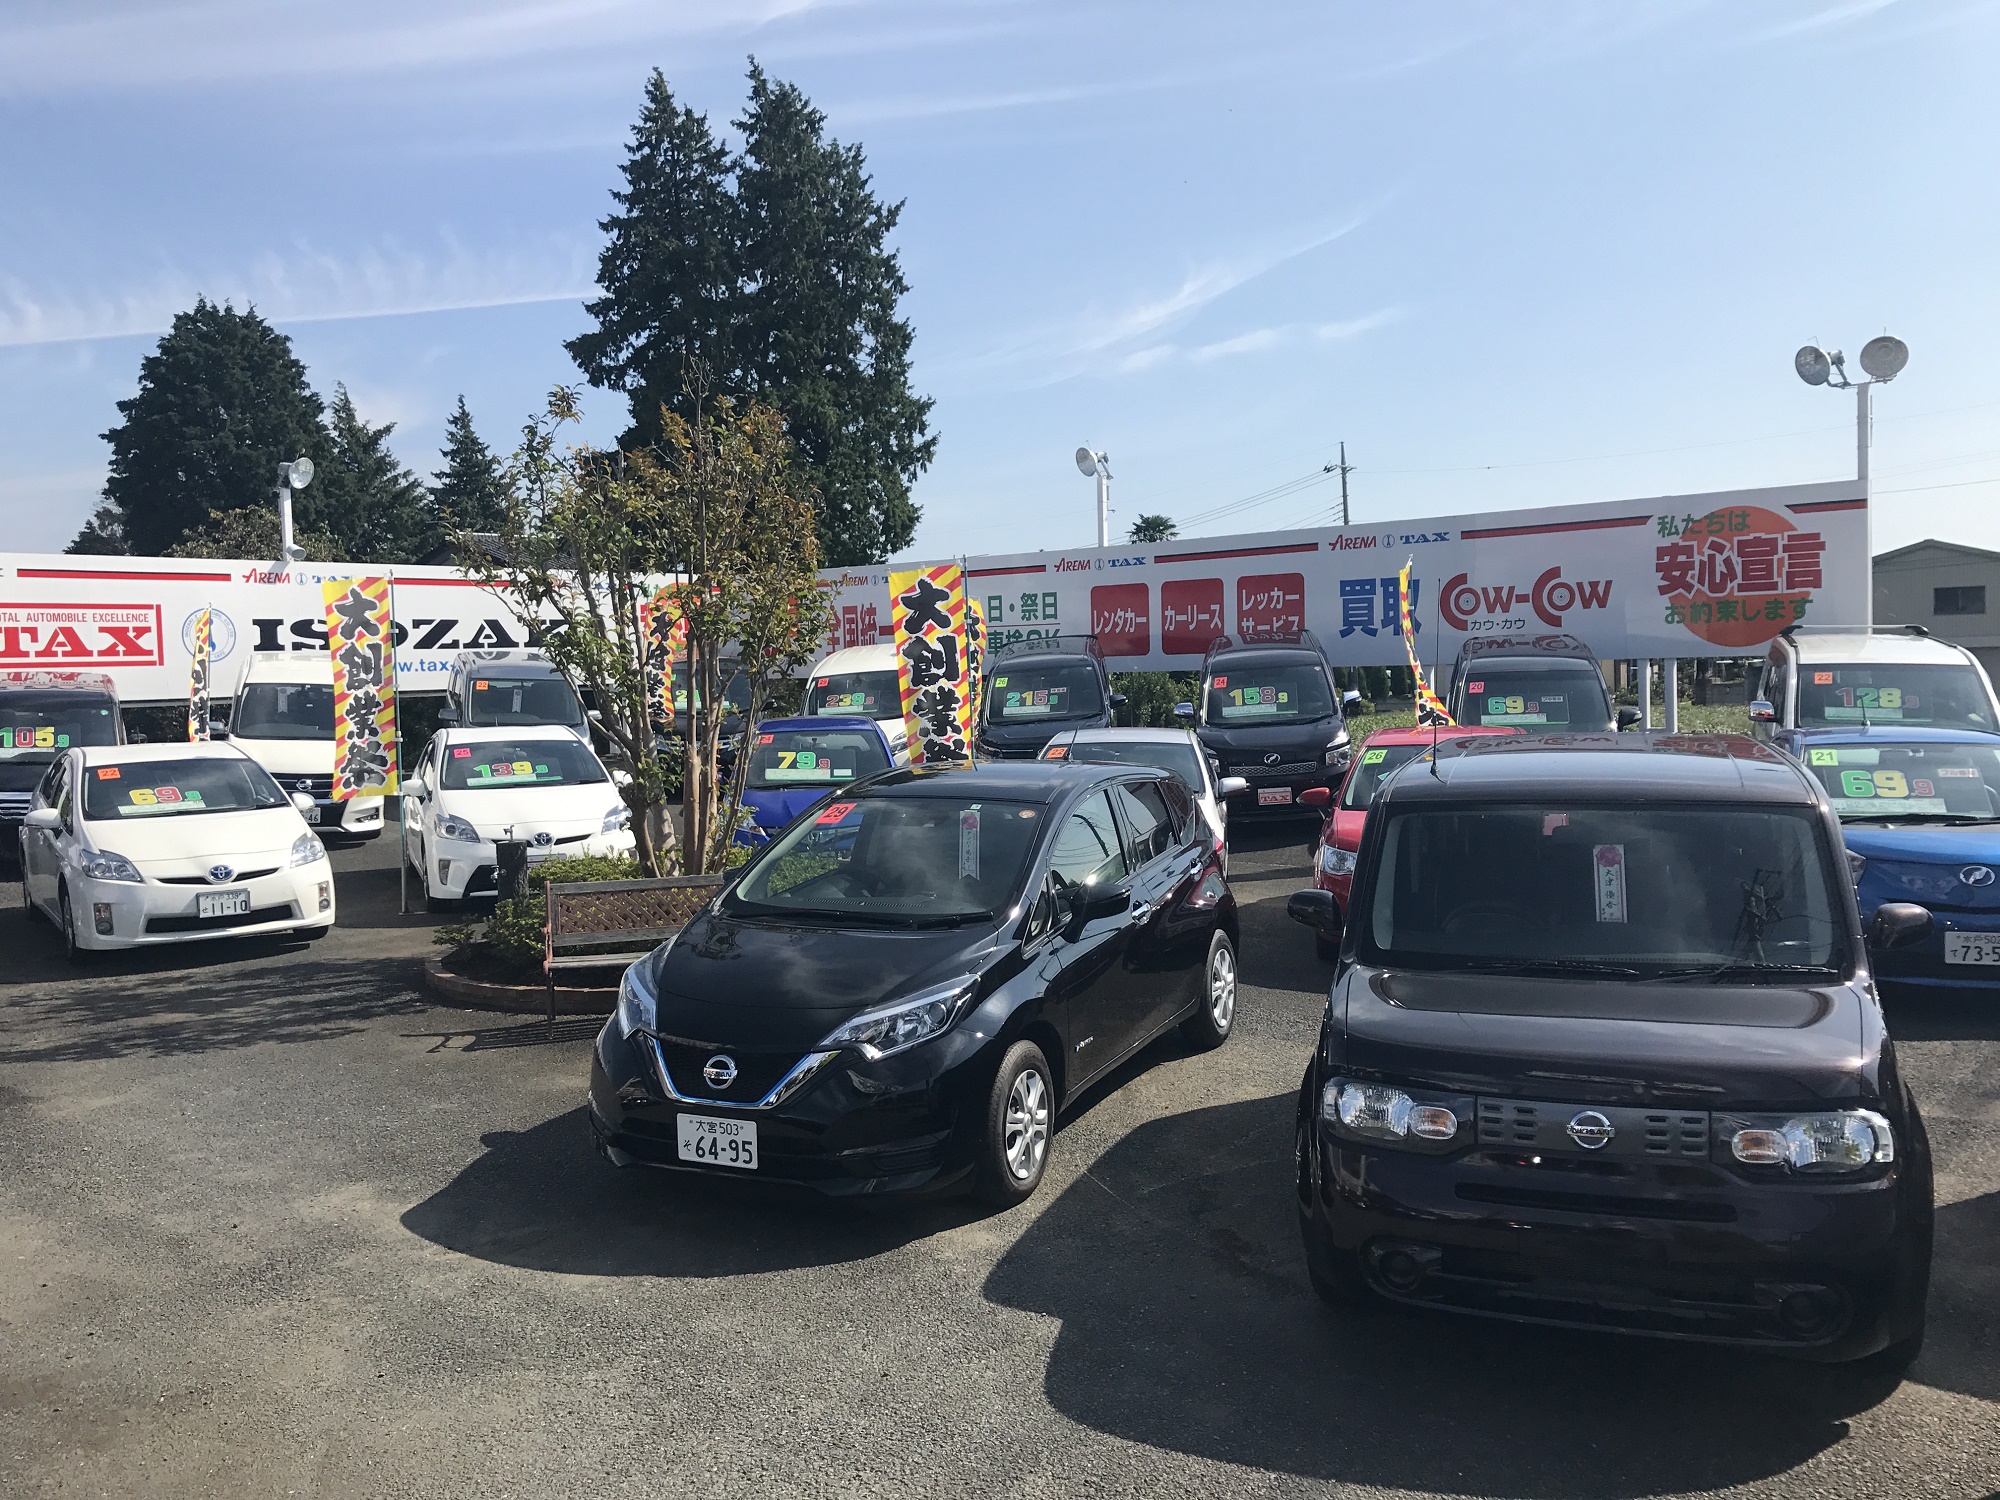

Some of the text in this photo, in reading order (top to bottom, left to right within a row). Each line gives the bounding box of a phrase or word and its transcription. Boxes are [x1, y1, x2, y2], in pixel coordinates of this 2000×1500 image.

[1657, 510, 1751, 538] 私たちは
[1329, 531, 1450, 552] ARENA TAX
[242, 567, 291, 585] ARENA
[1053, 556, 1147, 573] ARENA TAX
[1655, 532, 1827, 597] 安心宣言
[987, 591, 1058, 623] 日・祭日
[1241, 586, 1300, 611] レッカー
[1338, 577, 1422, 639] 買取
[26, 612, 88, 623] AUTOMOBILE
[92, 612, 149, 623] EXCELLENCE
[1093, 608, 1147, 635] レンタカー
[1163, 603, 1223, 632] カーリース
[1664, 597, 1814, 625] お約束します
[1241, 614, 1300, 633] サービス
[1470, 617, 1526, 631] カウ・カウ
[0, 626, 154, 658] TAX
[333, 587, 388, 791] 大創業祭
[1367, 752, 1384, 761] 26
[1814, 751, 1835, 762] 21
[1841, 769, 1936, 798] 69.9
[1261, 794, 1290, 803] TAX
[823, 805, 850, 818] 29
[211, 899, 248, 916] 11-10
[719, 1121, 740, 1136] 503
[695, 1135, 753, 1165] 64-95
